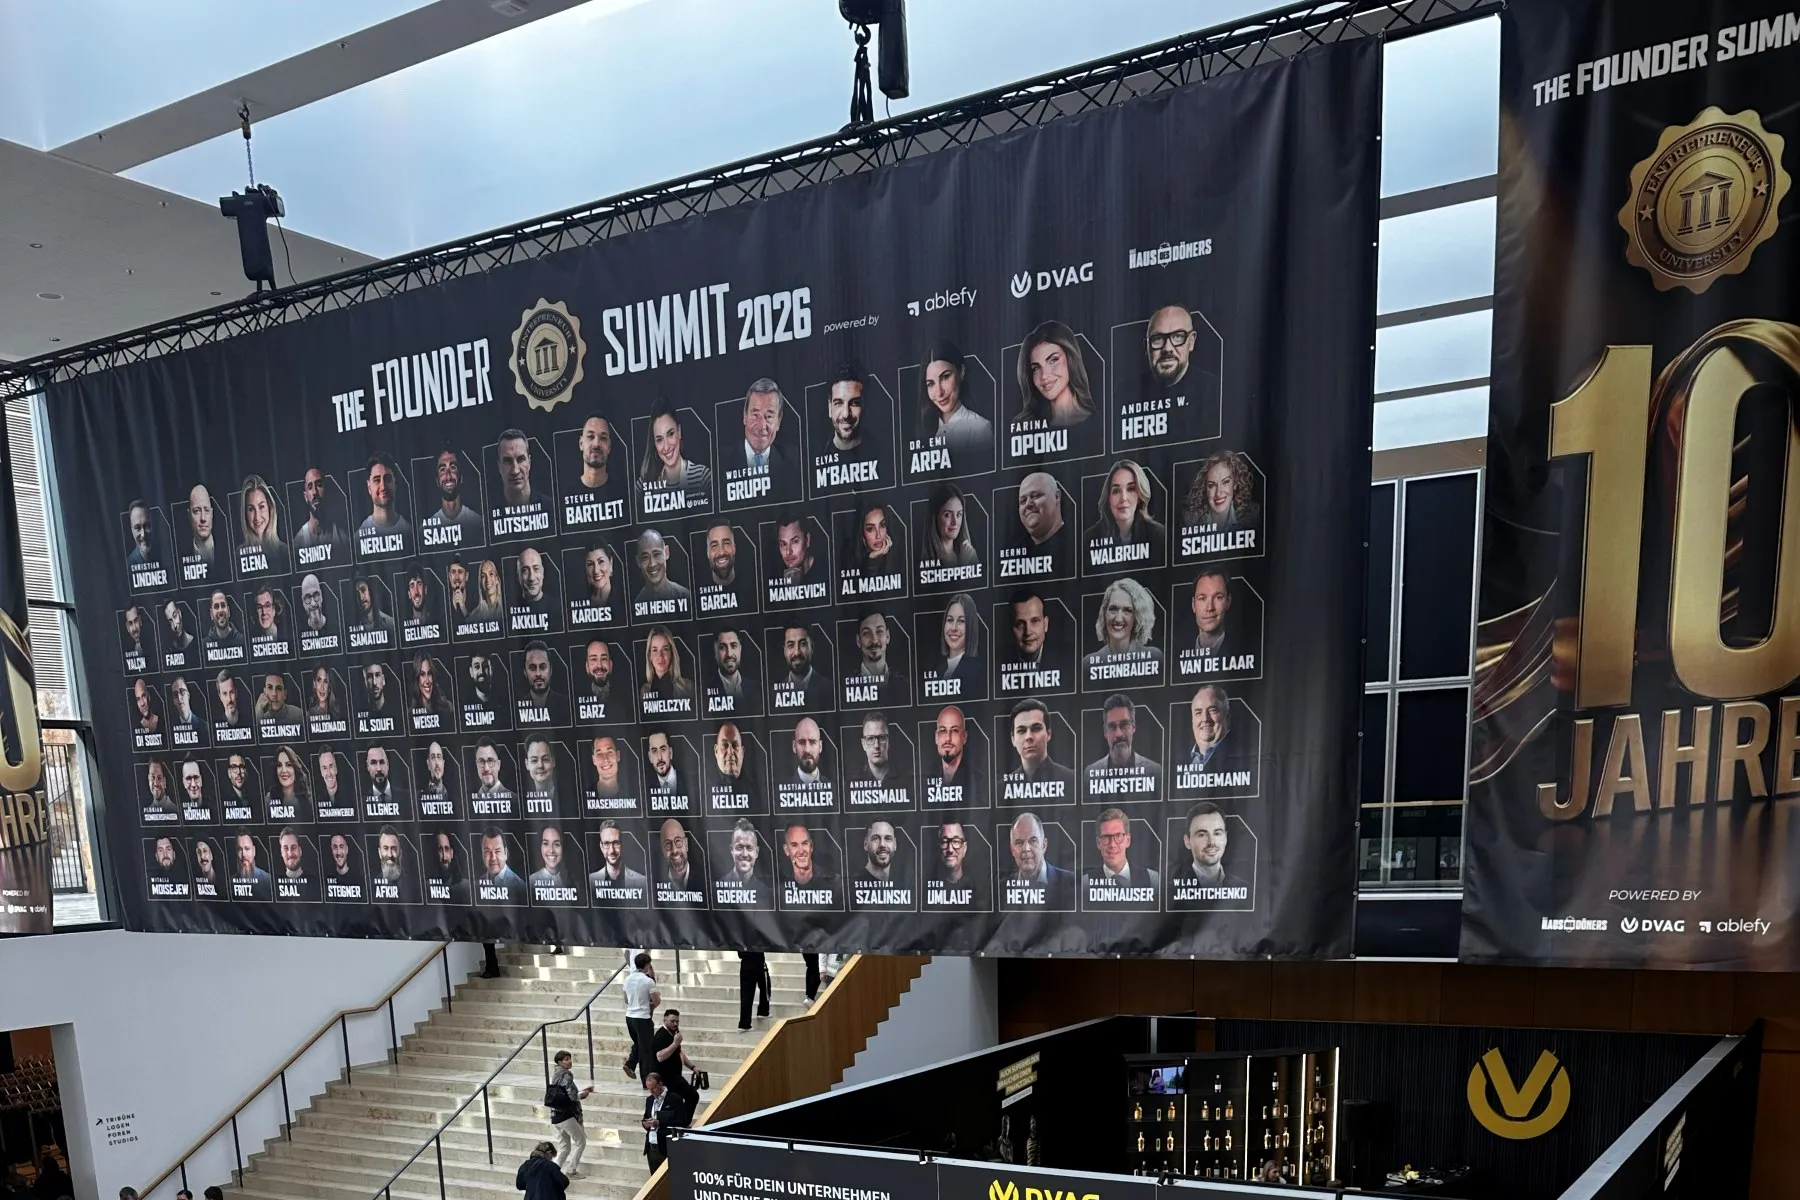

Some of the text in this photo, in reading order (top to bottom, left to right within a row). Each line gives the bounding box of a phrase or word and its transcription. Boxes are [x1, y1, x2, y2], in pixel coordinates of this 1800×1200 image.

[1533, 73, 1571, 107] THE
[1577, 34, 1708, 95] FOUNDER
[1649, 132, 1763, 192] ENTREPRENEUR
[1660, 230, 1744, 269] UNIVERSITY
[1130, 249, 1156, 269] HAUS
[1037, 262, 1093, 291] DVAG
[925, 287, 977, 312] ablefy
[824, 314, 880, 335] powered by
[332, 282, 811, 432] THE FOUNDER SUMMIT 2026
[1121, 396, 1188, 415] ANDREAS W.
[1011, 419, 1048, 432] FARINA
[1122, 412, 1167, 440] HERB
[910, 436, 946, 450] DR. EMI
[1011, 429, 1067, 457] OPOKU
[816, 453, 839, 465] ELYAS
[910, 449, 951, 474] ARPA
[726, 465, 769, 479] WOLFGANG
[643, 480, 667, 490] SALLY
[726, 477, 770, 501] GRUPP
[565, 494, 594, 504] STEVEN
[644, 490, 685, 514] ÖZCAN
[566, 500, 623, 525] BARTLETT
[1548, 319, 1800, 712] 10
[493, 513, 549, 535] KLITSCHKO
[1182, 523, 1217, 535] DAGMAR
[360, 534, 403, 555] NERLICH
[1090, 537, 1113, 547] ALINA
[1182, 530, 1255, 556] SCHULLER
[299, 544, 332, 564] SHINDY
[1000, 548, 1027, 558] BERND
[1090, 543, 1149, 566] WALBRUN
[241, 555, 268, 572] ELENA
[920, 560, 940, 568] ANNA
[1000, 556, 1052, 577] ZEHNER
[132, 570, 167, 588] LINDNER
[184, 564, 207, 580] HOPF
[841, 569, 860, 577] SARA
[921, 564, 982, 584] SCHEPPERLE
[842, 574, 901, 595] AL MADANI
[769, 583, 826, 602] MANKEVICH
[635, 599, 687, 616] SHI HENG YI
[701, 593, 738, 612] GARCIA
[456, 622, 500, 636] JONAS LISA
[253, 643, 289, 657] SCHERER
[1090, 651, 1151, 664] DR. CHRISTINA
[1180, 648, 1210, 658] JULIUS
[1002, 662, 1037, 672] DOMINIK
[1090, 661, 1159, 680] STERNBAUER
[1180, 655, 1254, 675] VAN DE LAAR
[846, 676, 884, 685] CHRISTIAN
[924, 671, 937, 679] LEA
[1002, 670, 1060, 690] KETTNER
[846, 685, 878, 702] HAAG
[925, 679, 961, 697] FEDER
[643, 699, 691, 714] PAWELCZYK
[708, 696, 734, 712] ACAR
[775, 691, 805, 708] ACAR
[465, 711, 494, 726] SLUMP
[519, 707, 550, 722] WALIA
[580, 704, 605, 719] GARZ
[413, 715, 440, 729] WEISER
[262, 724, 300, 737] SZELINSKY
[1537, 696, 1800, 821] JAHRE
[1090, 767, 1145, 777] CHRISTOPHER
[1177, 764, 1203, 772] MARIO
[1090, 777, 1155, 794] HANFSTEIN
[1177, 771, 1250, 789] LÜDDEMANN
[851, 789, 910, 804] KUSSMAUL
[1004, 781, 1064, 799] AMACKER
[473, 800, 511, 814] VOETTER
[527, 799, 552, 813] OTTO
[652, 795, 688, 810] BAR BAR
[713, 794, 749, 809] KELLER
[780, 792, 833, 808] SCHALLER
[270, 806, 295, 819] MISAR
[280, 885, 300, 897] SAAL
[480, 887, 508, 900] MISAR
[535, 888, 577, 901] FRIDERIC
[657, 891, 703, 902] SCHLICHTING
[717, 890, 757, 904] GOERKE
[785, 887, 832, 904] GÄRTNER
[855, 890, 911, 904] SZALINSKI
[928, 890, 972, 904] UMLAUF
[1007, 889, 1045, 904] HEYNE
[1090, 888, 1154, 901] DONHAUSER
[1174, 887, 1247, 900] JACHTCHENKO
[1609, 890, 1701, 900] POWERED BY
[1642, 920, 1684, 932] DVAG
[1717, 918, 1770, 935] ablefy
[106, 1113, 135, 1123] TRIBÜNE
[107, 1122, 130, 1130] LOGEN
[108, 1130, 130, 1138] FOREN
[109, 1136, 138, 1146] STUDIOS
[693, 1172, 724, 1186] 100%
[727, 1174, 751, 1189] FÜR
[755, 1179, 784, 1193] DEIN
